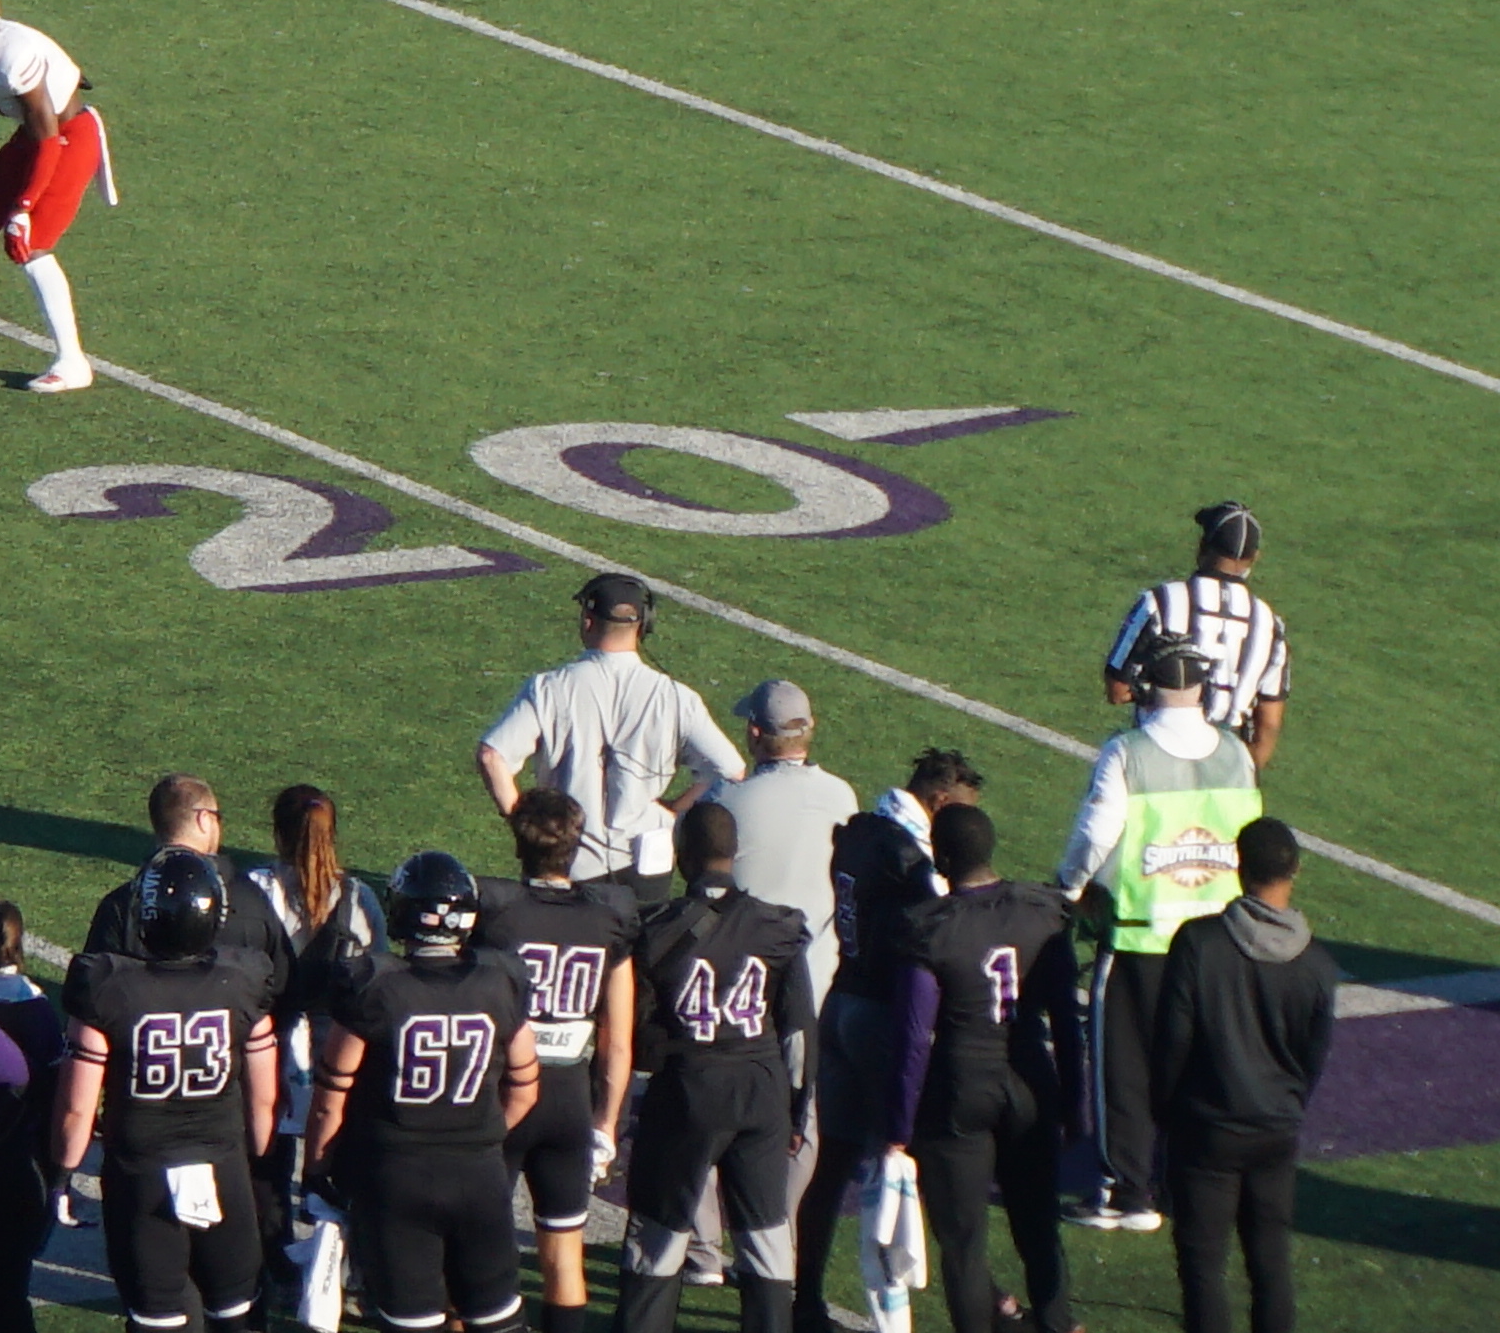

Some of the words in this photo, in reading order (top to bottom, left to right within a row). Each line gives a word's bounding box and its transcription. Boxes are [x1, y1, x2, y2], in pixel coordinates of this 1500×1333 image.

[1197, 614, 1249, 688] H
[1143, 842, 1238, 875] SOUTHLAN
[675, 955, 767, 1042] 44
[983, 945, 1019, 1025] 1
[131, 1009, 231, 1100] 63
[394, 1012, 495, 1105] 67
